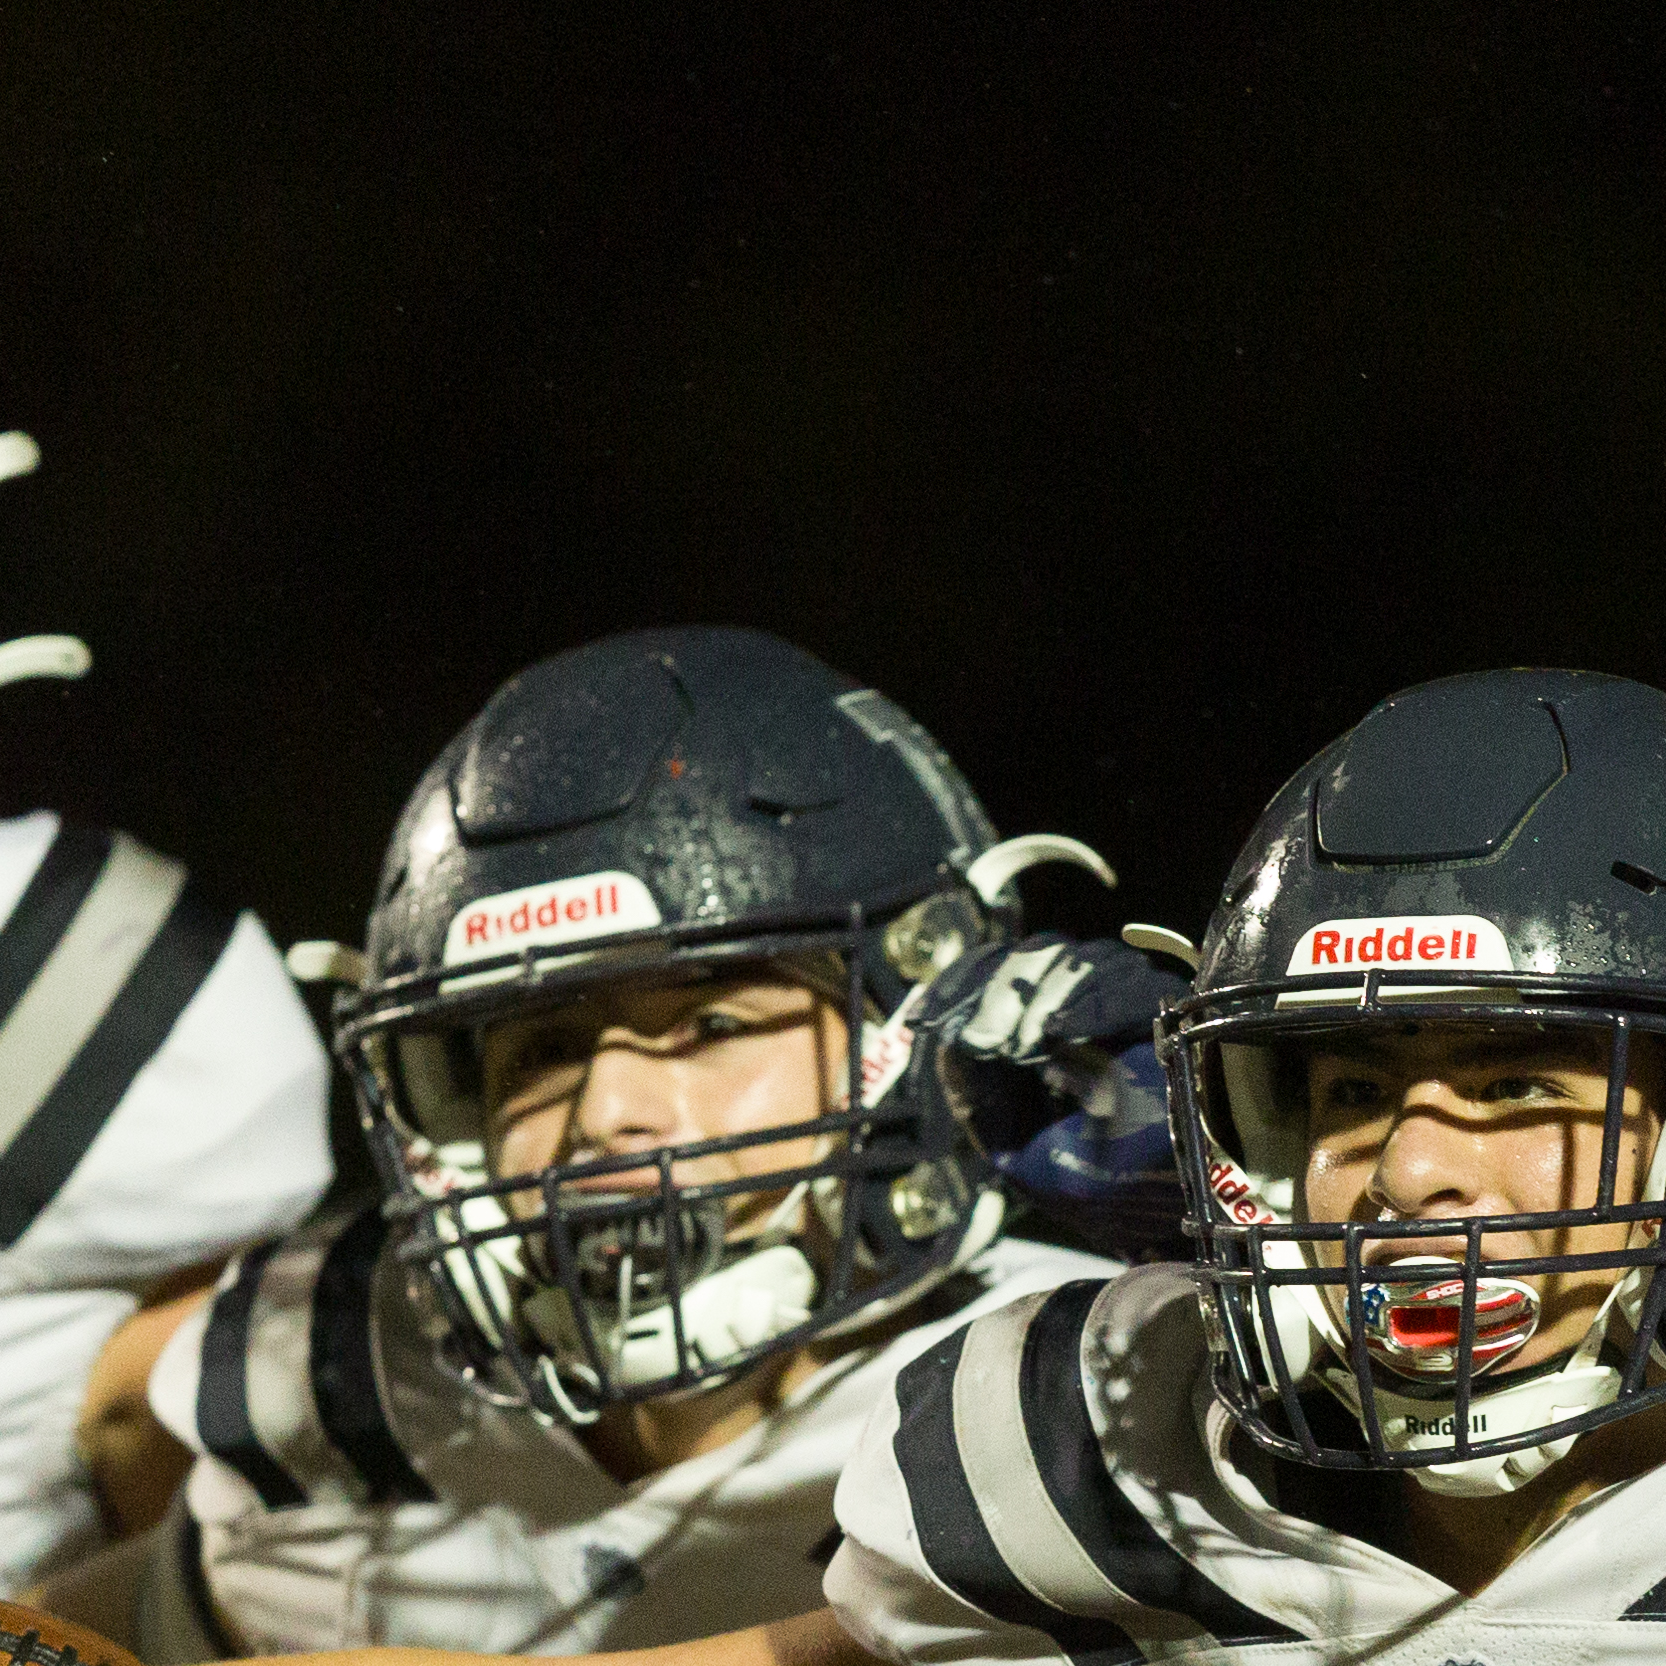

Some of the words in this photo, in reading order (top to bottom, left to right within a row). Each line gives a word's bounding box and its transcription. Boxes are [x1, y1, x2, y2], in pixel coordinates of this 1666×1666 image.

[465, 884, 620, 947] Riddell
[1310, 926, 1477, 965] Riddell
[1426, 1280, 1464, 1300] SHOC
[1404, 1413, 1488, 1436] Riddll
